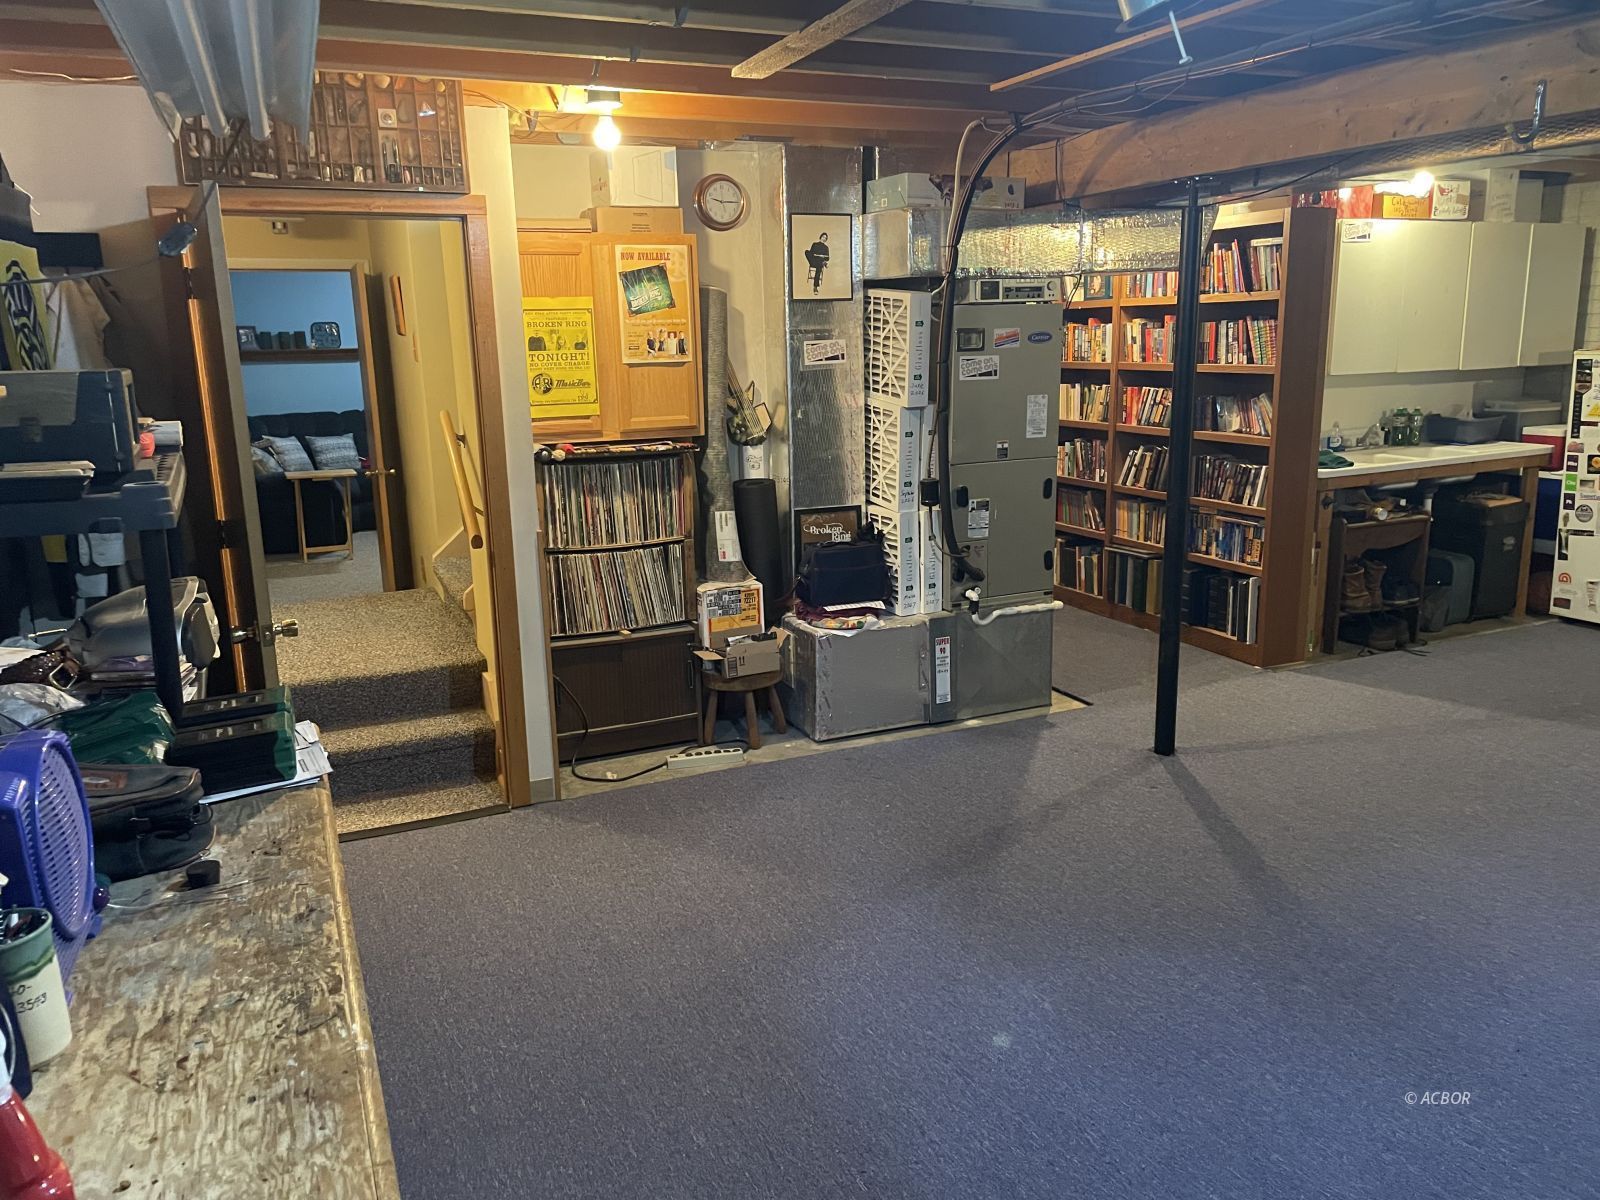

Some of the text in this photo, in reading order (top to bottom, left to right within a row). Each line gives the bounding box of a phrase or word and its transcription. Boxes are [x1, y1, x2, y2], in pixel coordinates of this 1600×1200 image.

[621, 252, 671, 260] NOW AVAILABLE
[529, 352, 590, 361] TONIGHT!
[961, 360, 983, 370] come
[962, 366, 983, 375] come
[804, 523, 843, 534] Broken
[832, 531, 851, 542] Ring
[936, 637, 950, 646] SUPER
